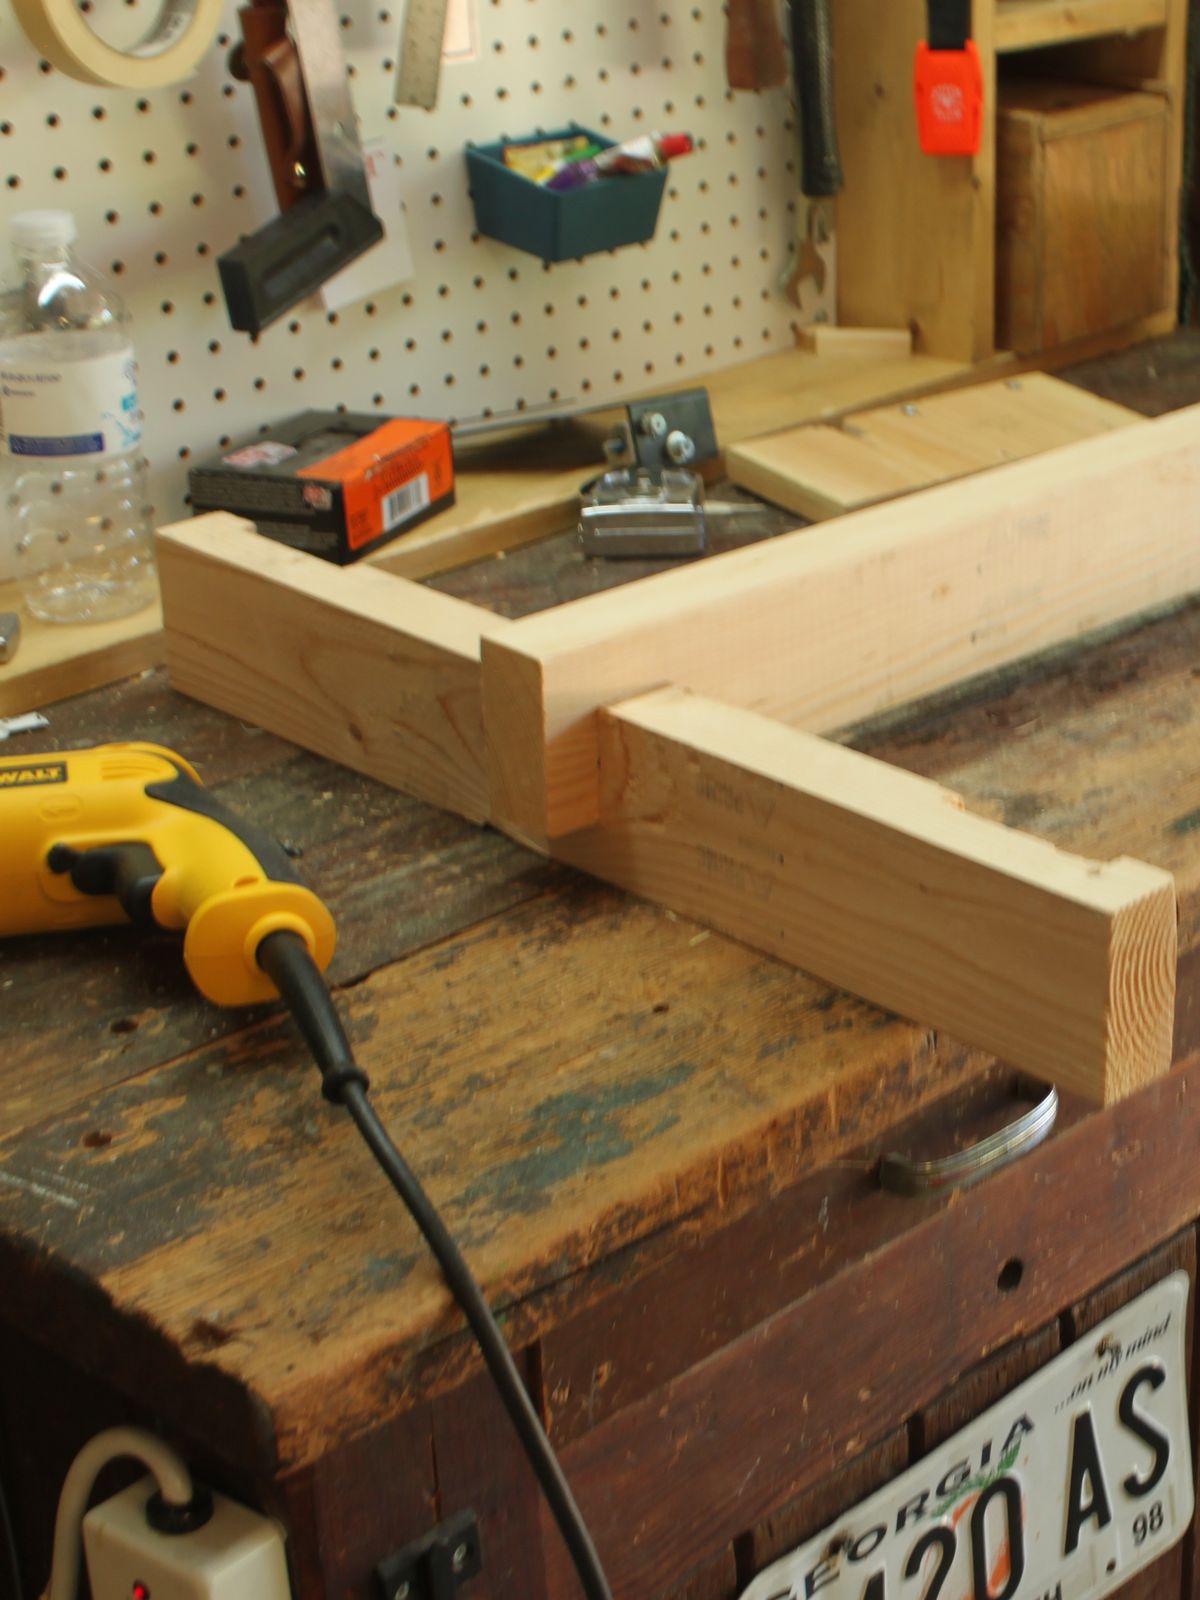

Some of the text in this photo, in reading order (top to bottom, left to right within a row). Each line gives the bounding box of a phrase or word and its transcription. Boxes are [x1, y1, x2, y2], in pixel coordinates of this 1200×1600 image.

[1125, 1310, 1171, 1360] mind
[766, 1414, 1034, 1600] EORGIA
[861, 1364, 1171, 1600] 20 AS
[1131, 1501, 1165, 1547] 98
